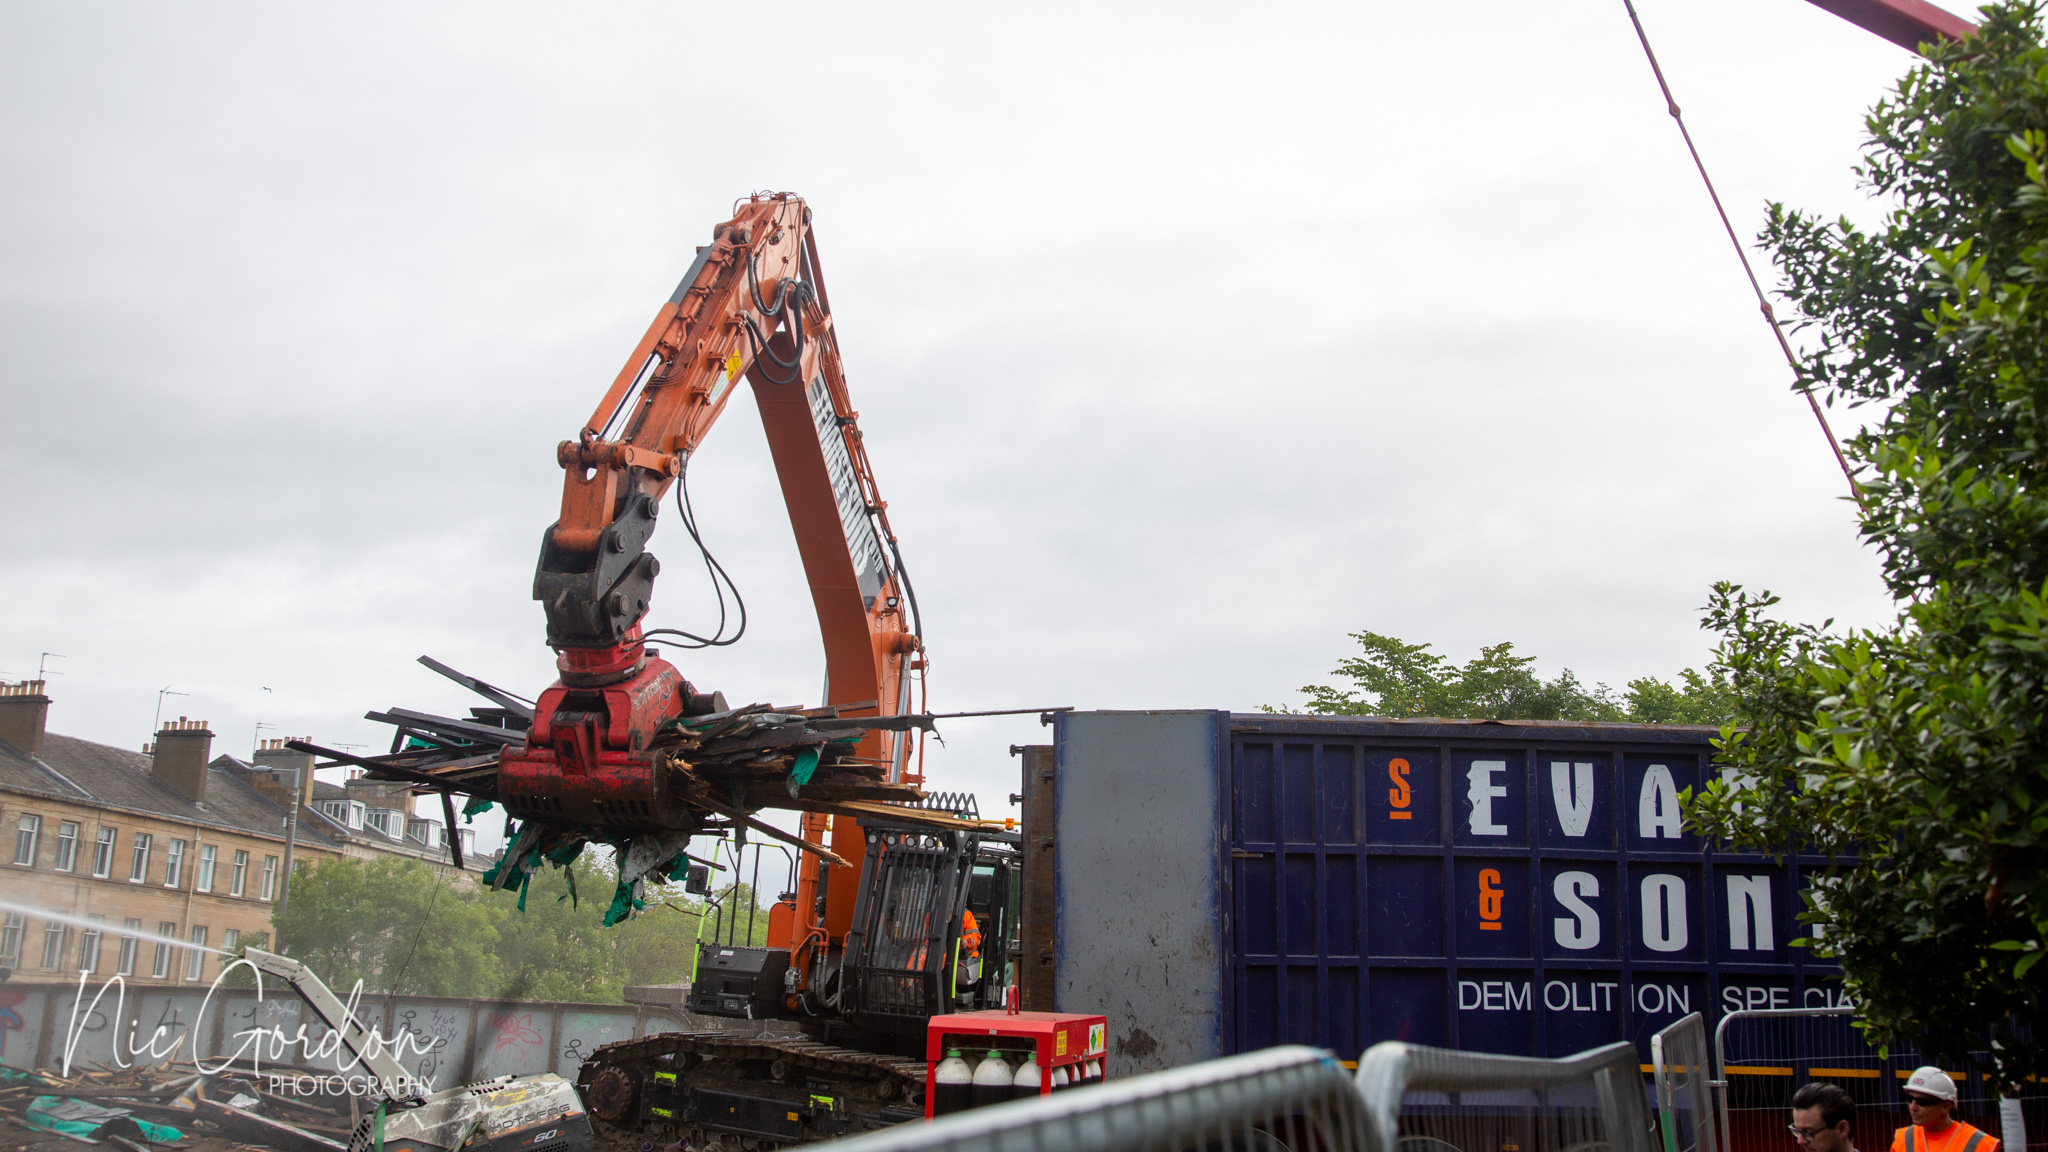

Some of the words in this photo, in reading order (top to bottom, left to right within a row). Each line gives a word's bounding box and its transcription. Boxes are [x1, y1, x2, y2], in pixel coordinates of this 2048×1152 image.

[1389, 757, 1412, 820] S
[1478, 868, 1504, 931] &
[1722, 985, 1866, 1017] SPECIA
